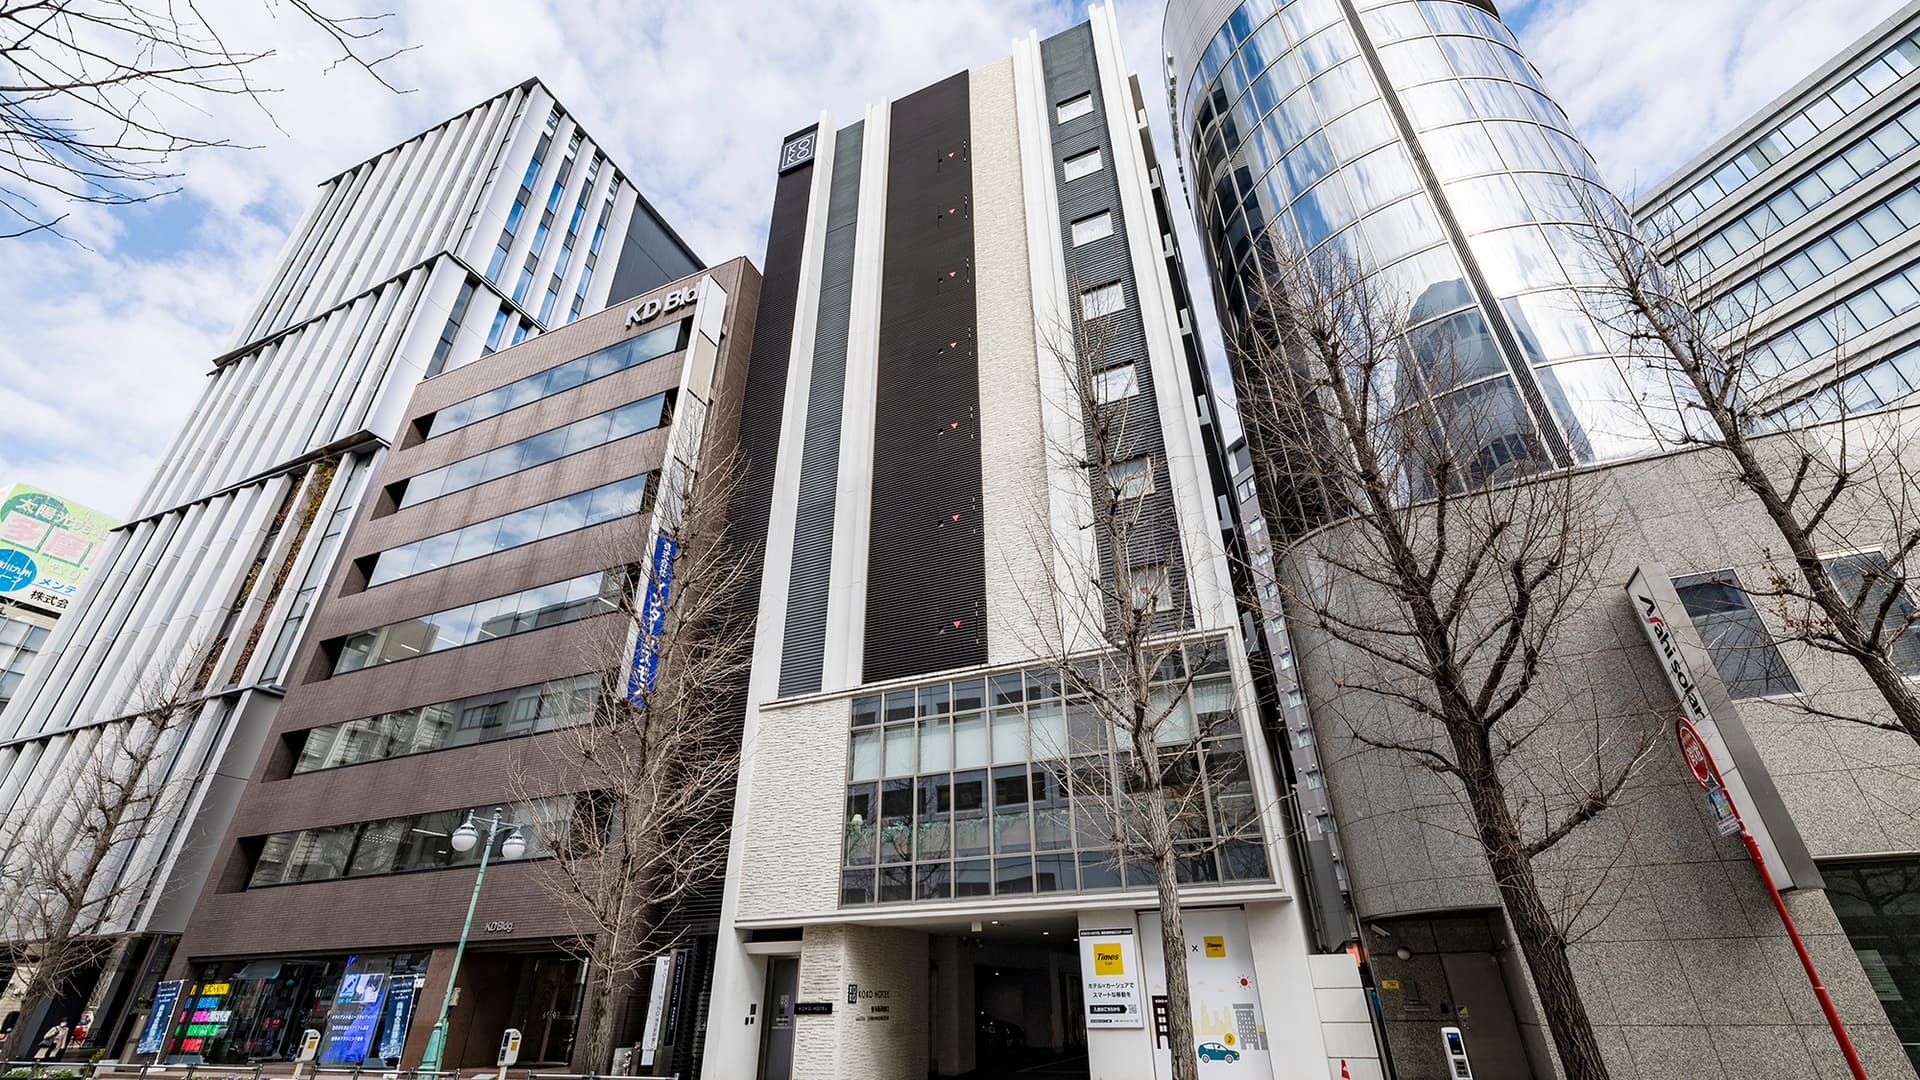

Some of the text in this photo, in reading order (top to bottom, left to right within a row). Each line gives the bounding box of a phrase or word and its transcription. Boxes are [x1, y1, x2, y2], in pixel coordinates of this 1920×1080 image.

[624, 298, 662, 329] KD
[30, 590, 69, 609] 株式会
[1671, 660, 1705, 719] solar
[1097, 952, 1120, 961] Times
